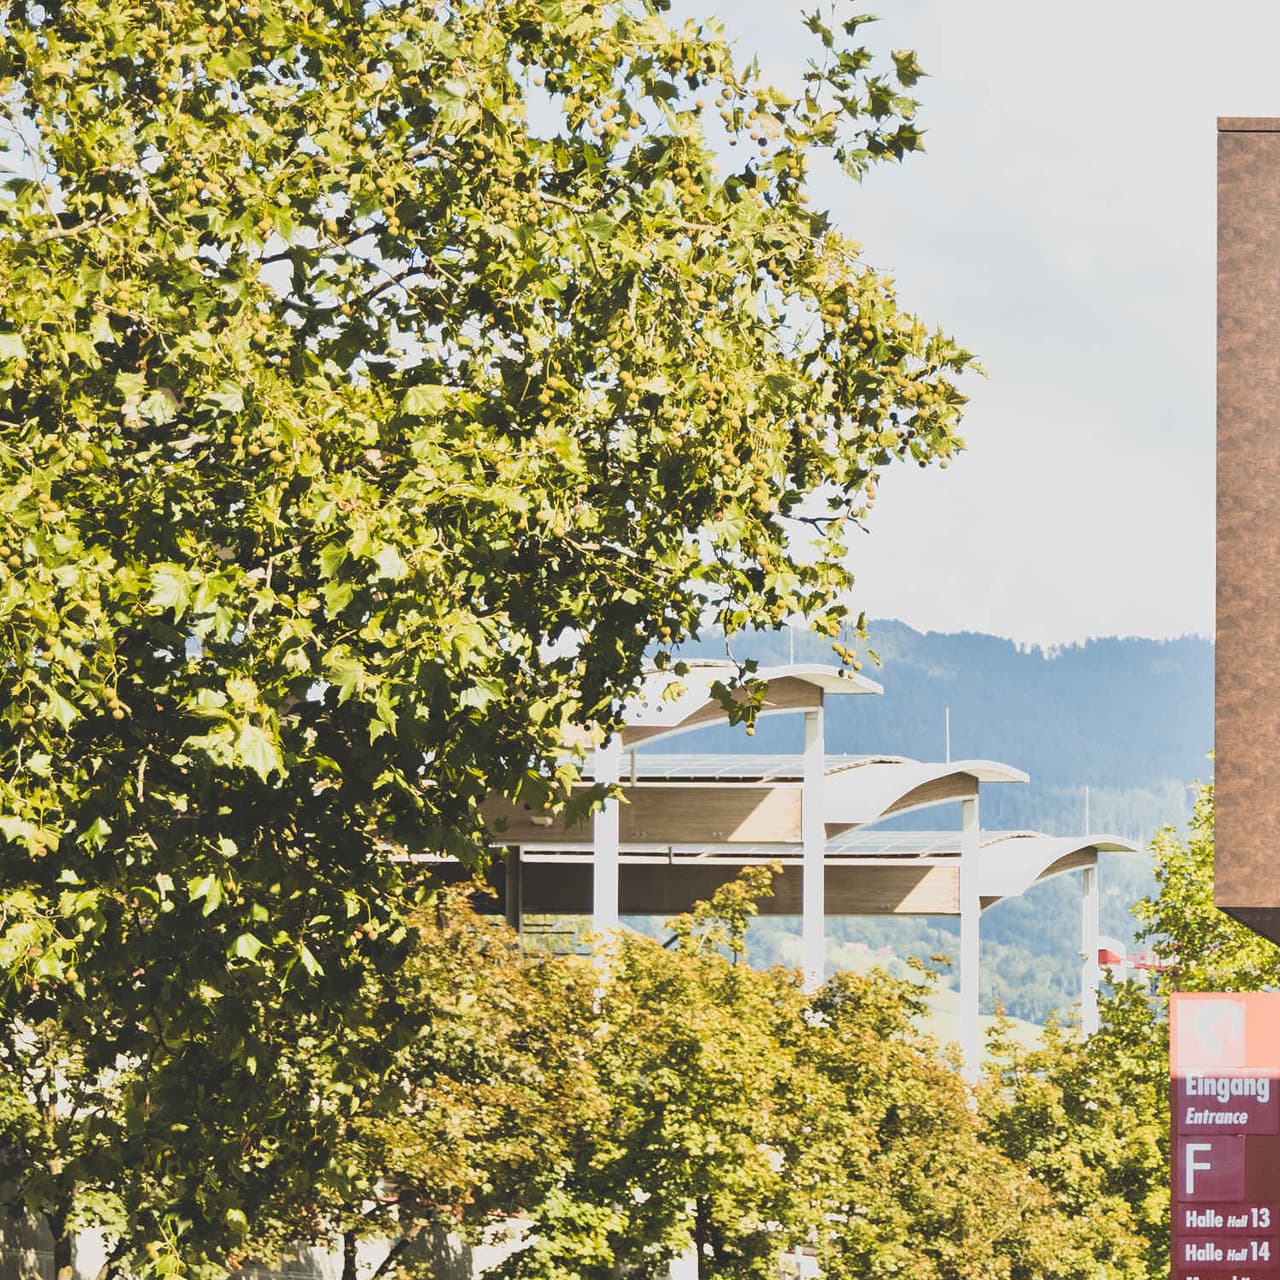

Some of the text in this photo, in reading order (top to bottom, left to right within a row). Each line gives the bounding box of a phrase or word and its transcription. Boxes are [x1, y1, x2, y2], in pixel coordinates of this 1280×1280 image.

[1185, 1071, 1271, 1104] Eingang
[1185, 1107, 1249, 1125] Entrance
[1185, 1143, 1212, 1195] F
[1185, 1207, 1271, 1228] Halle Hall 13
[1185, 1241, 1271, 1261] Halle Hall 14
